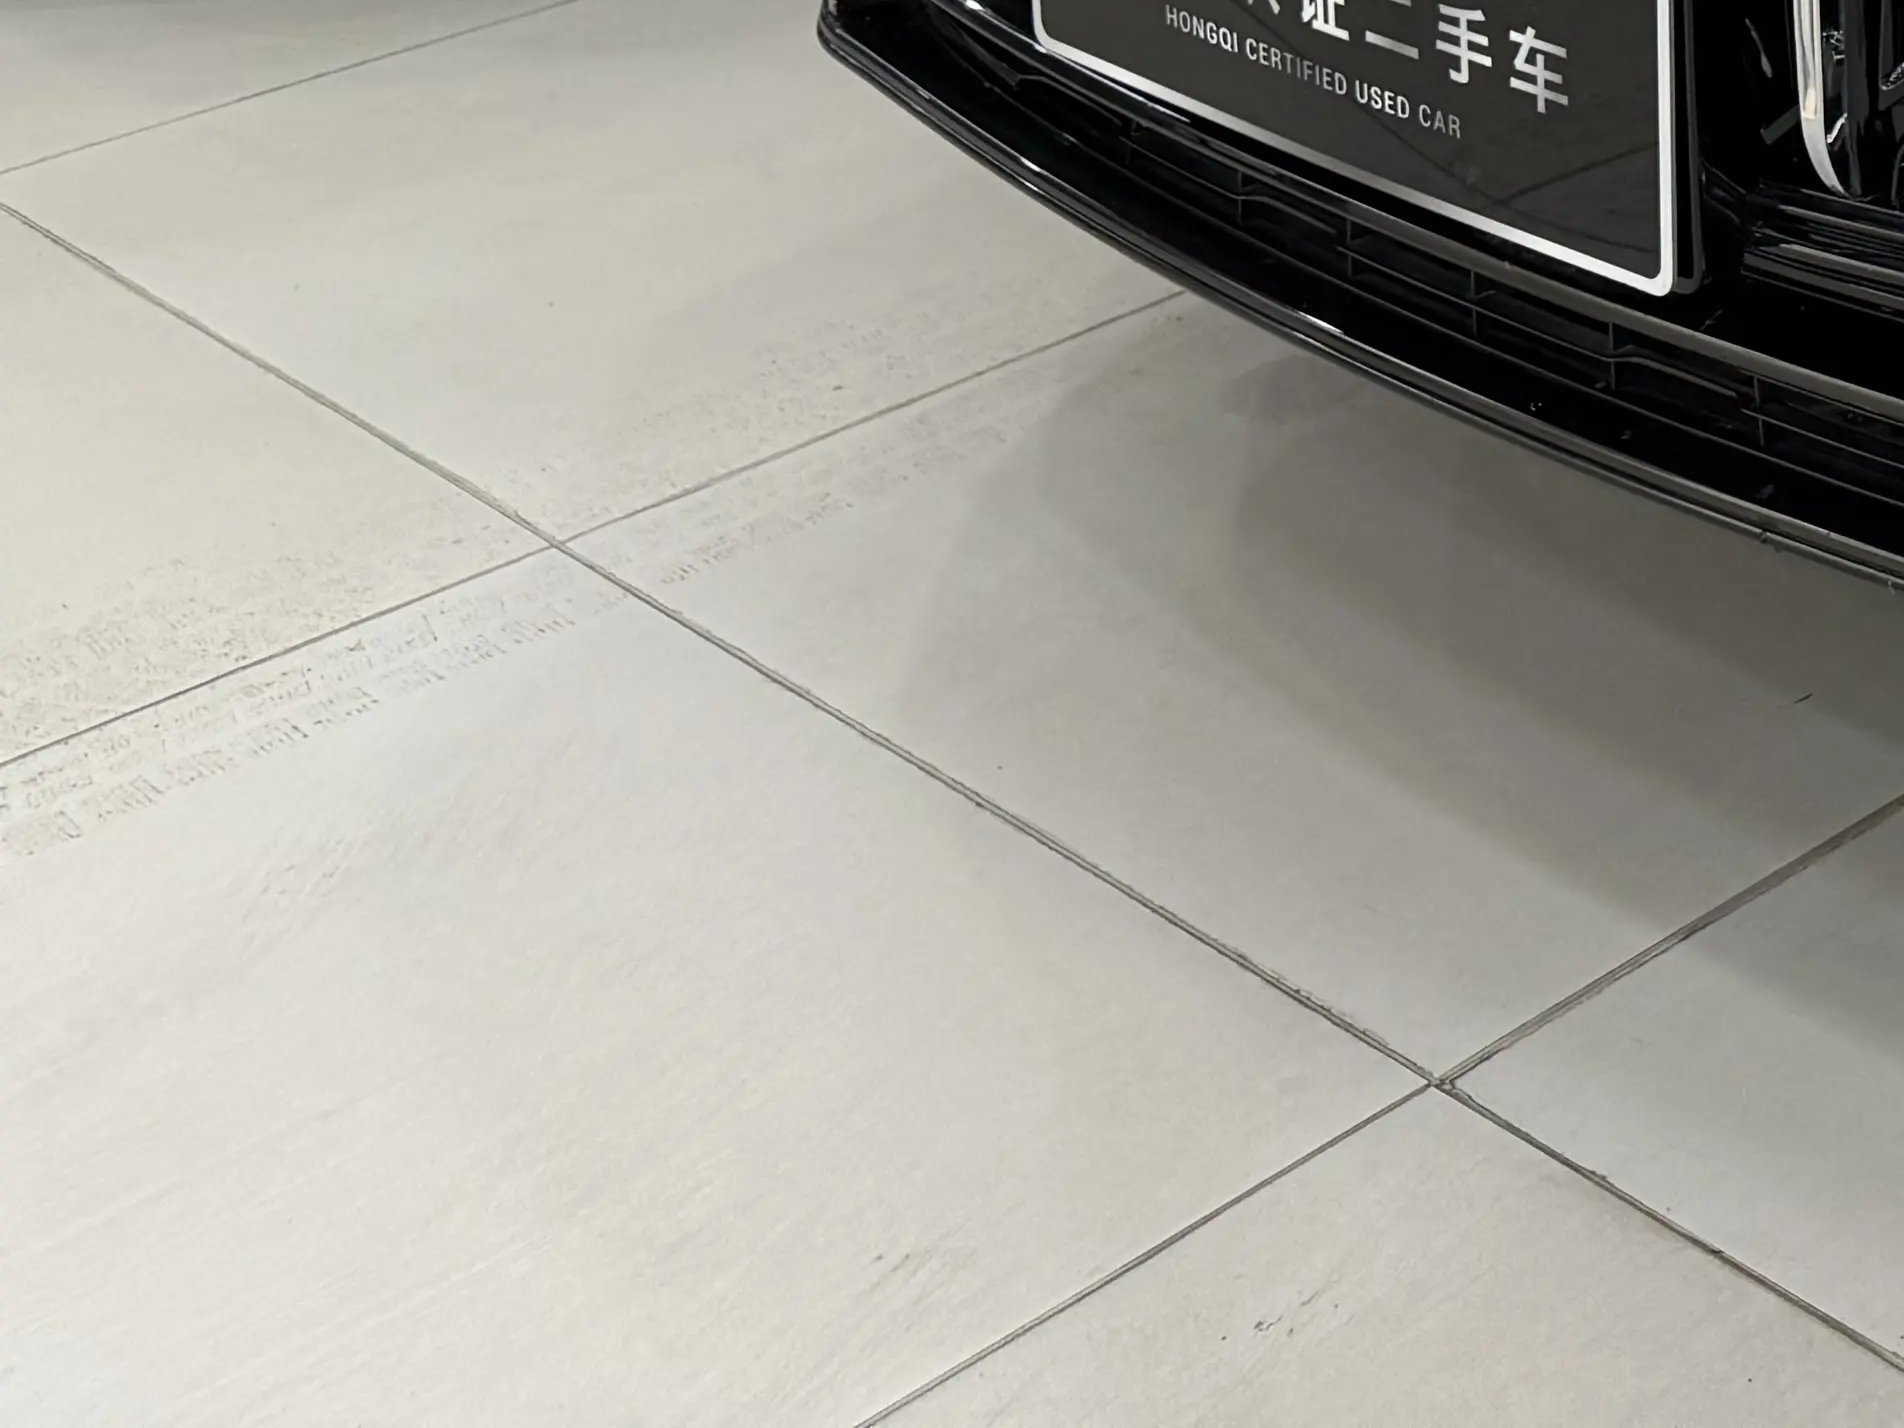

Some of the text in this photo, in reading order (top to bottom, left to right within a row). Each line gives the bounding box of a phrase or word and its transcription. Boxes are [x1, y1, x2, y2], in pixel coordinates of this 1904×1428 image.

[1165, 4, 1462, 139] HONGQI CERTIFIED USED CAR
